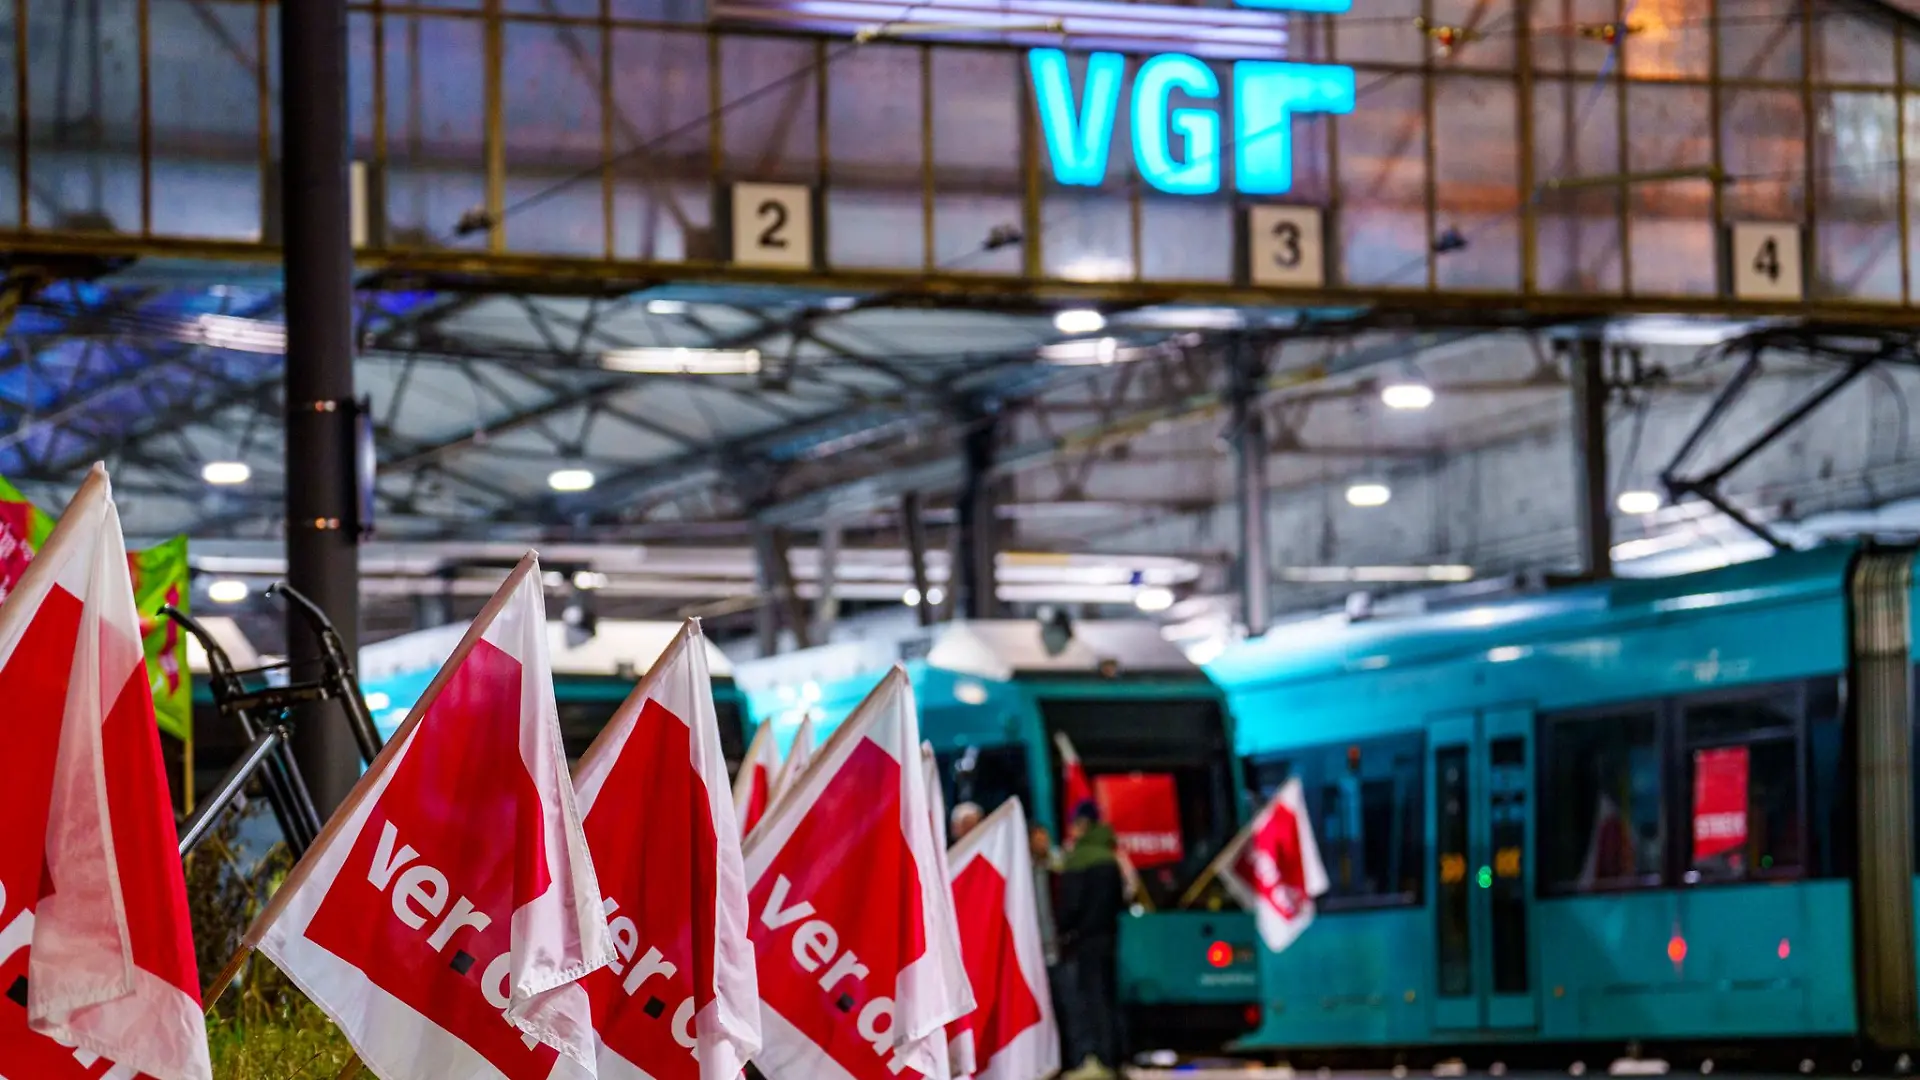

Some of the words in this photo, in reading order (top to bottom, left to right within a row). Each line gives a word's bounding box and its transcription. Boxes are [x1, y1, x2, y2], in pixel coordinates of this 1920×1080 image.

[756, 200, 788, 249] 2
[1271, 220, 1304, 268] 3
[1752, 235, 1783, 283] 4
